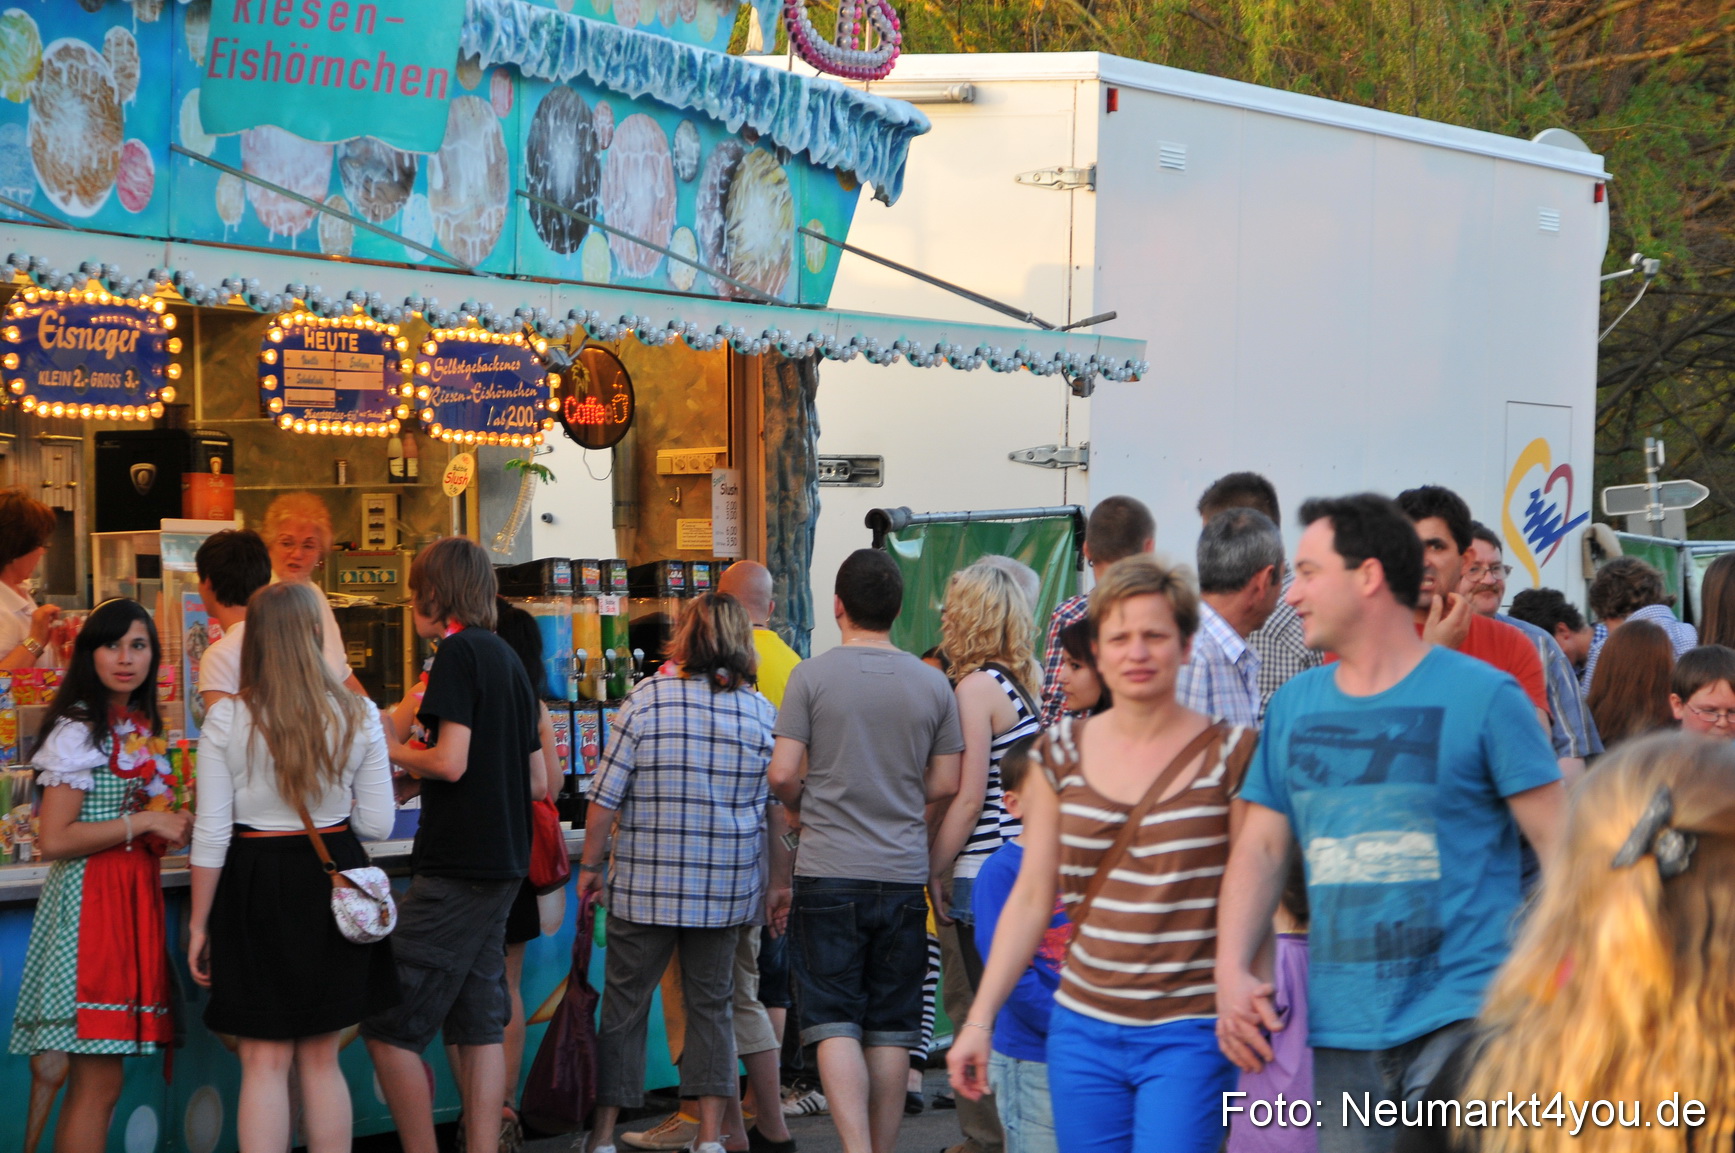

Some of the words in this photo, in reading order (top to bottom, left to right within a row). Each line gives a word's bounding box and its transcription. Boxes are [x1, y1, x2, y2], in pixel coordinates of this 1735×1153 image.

[207, 37, 449, 100] Eishörnchen
[38, 309, 140, 360] Eisneger
[303, 326, 359, 352] HEUTE
[38, 370, 73, 387] KLEIN
[90, 371, 121, 389] GROSS
[431, 354, 521, 382] Selbstgebackenes
[564, 395, 613, 425] Coffee
[444, 471, 469, 485] Slush
[720, 483, 739, 496] Slush
